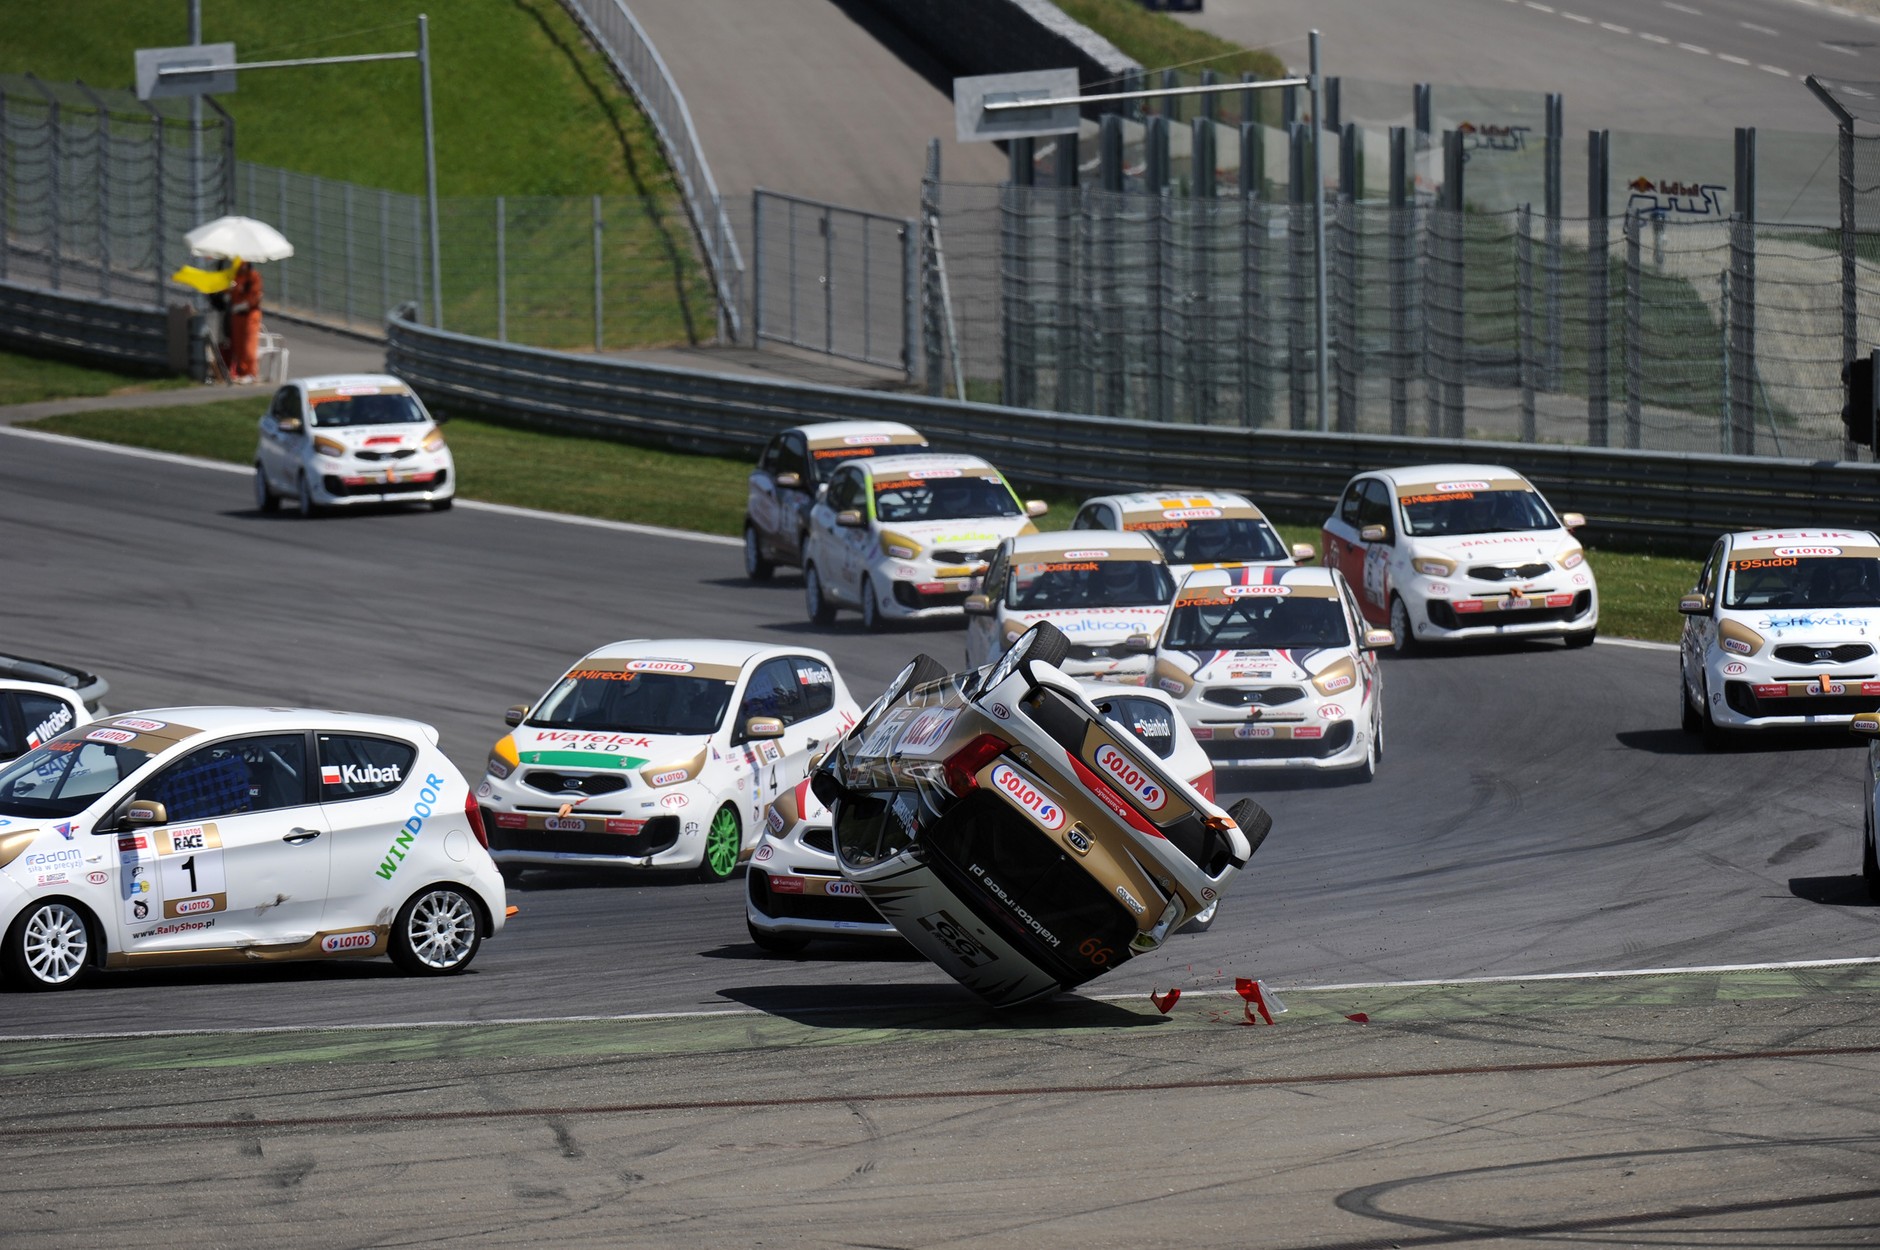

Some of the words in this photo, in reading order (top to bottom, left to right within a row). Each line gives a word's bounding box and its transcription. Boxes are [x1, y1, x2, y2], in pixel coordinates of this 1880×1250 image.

[1752, 533, 1855, 541] DELIK
[1732, 641, 1749, 652] LOTOS
[648, 662, 688, 671] LOTOS
[1726, 665, 1743, 674] KIA
[1333, 677, 1350, 687] LOTOS
[994, 703, 1009, 719] KIA
[1321, 706, 1342, 717] KIA
[36, 702, 73, 742] Wróbel
[102, 730, 132, 742] LOTOS
[1248, 728, 1271, 737] LOTOS
[536, 731, 656, 748] Wafelek
[583, 742, 598, 751] &
[603, 744, 620, 752] D
[340, 763, 402, 784] Kubat
[1102, 751, 1146, 791] LOTOS
[663, 772, 685, 783] LOTOS
[768, 764, 779, 796] 4
[998, 771, 1043, 811] LOTOS
[665, 796, 686, 805] KIA
[1094, 786, 1119, 812] Santander
[375, 773, 445, 881] WINDOOR
[558, 821, 582, 830] LOTOS
[183, 827, 202, 836] LOTOS
[173, 834, 203, 851] RACE
[1071, 832, 1086, 848] KIA
[757, 849, 771, 860] KIA
[90, 874, 105, 882] KIA
[181, 855, 198, 893] 1
[840, 884, 861, 895] LOTO
[188, 900, 210, 911] LOTOS
[132, 918, 216, 940] www.RallyShop.pl
[338, 935, 371, 949] LOTOS
